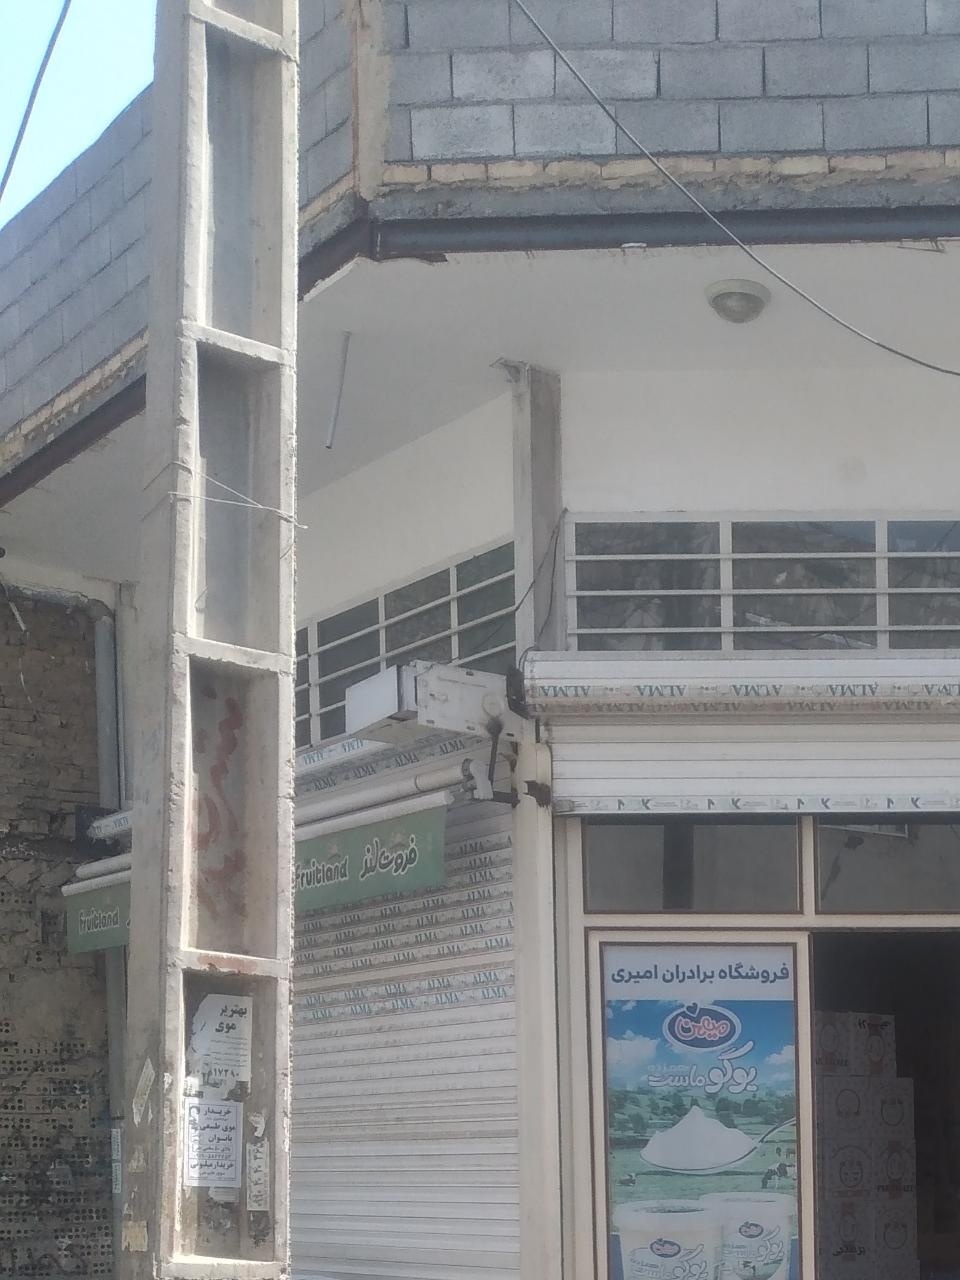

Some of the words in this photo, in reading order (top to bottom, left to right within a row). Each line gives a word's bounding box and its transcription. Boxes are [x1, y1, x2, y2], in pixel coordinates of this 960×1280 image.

[611, 964, 658, 984] امیری
[662, 964, 715, 984] برادران
[718, 962, 790, 984] فروشگاه
[674, 1015, 731, 1041] میهن
[704, 1040, 759, 1095] یوگو
[203, 1107, 232, 1117] خریدار
